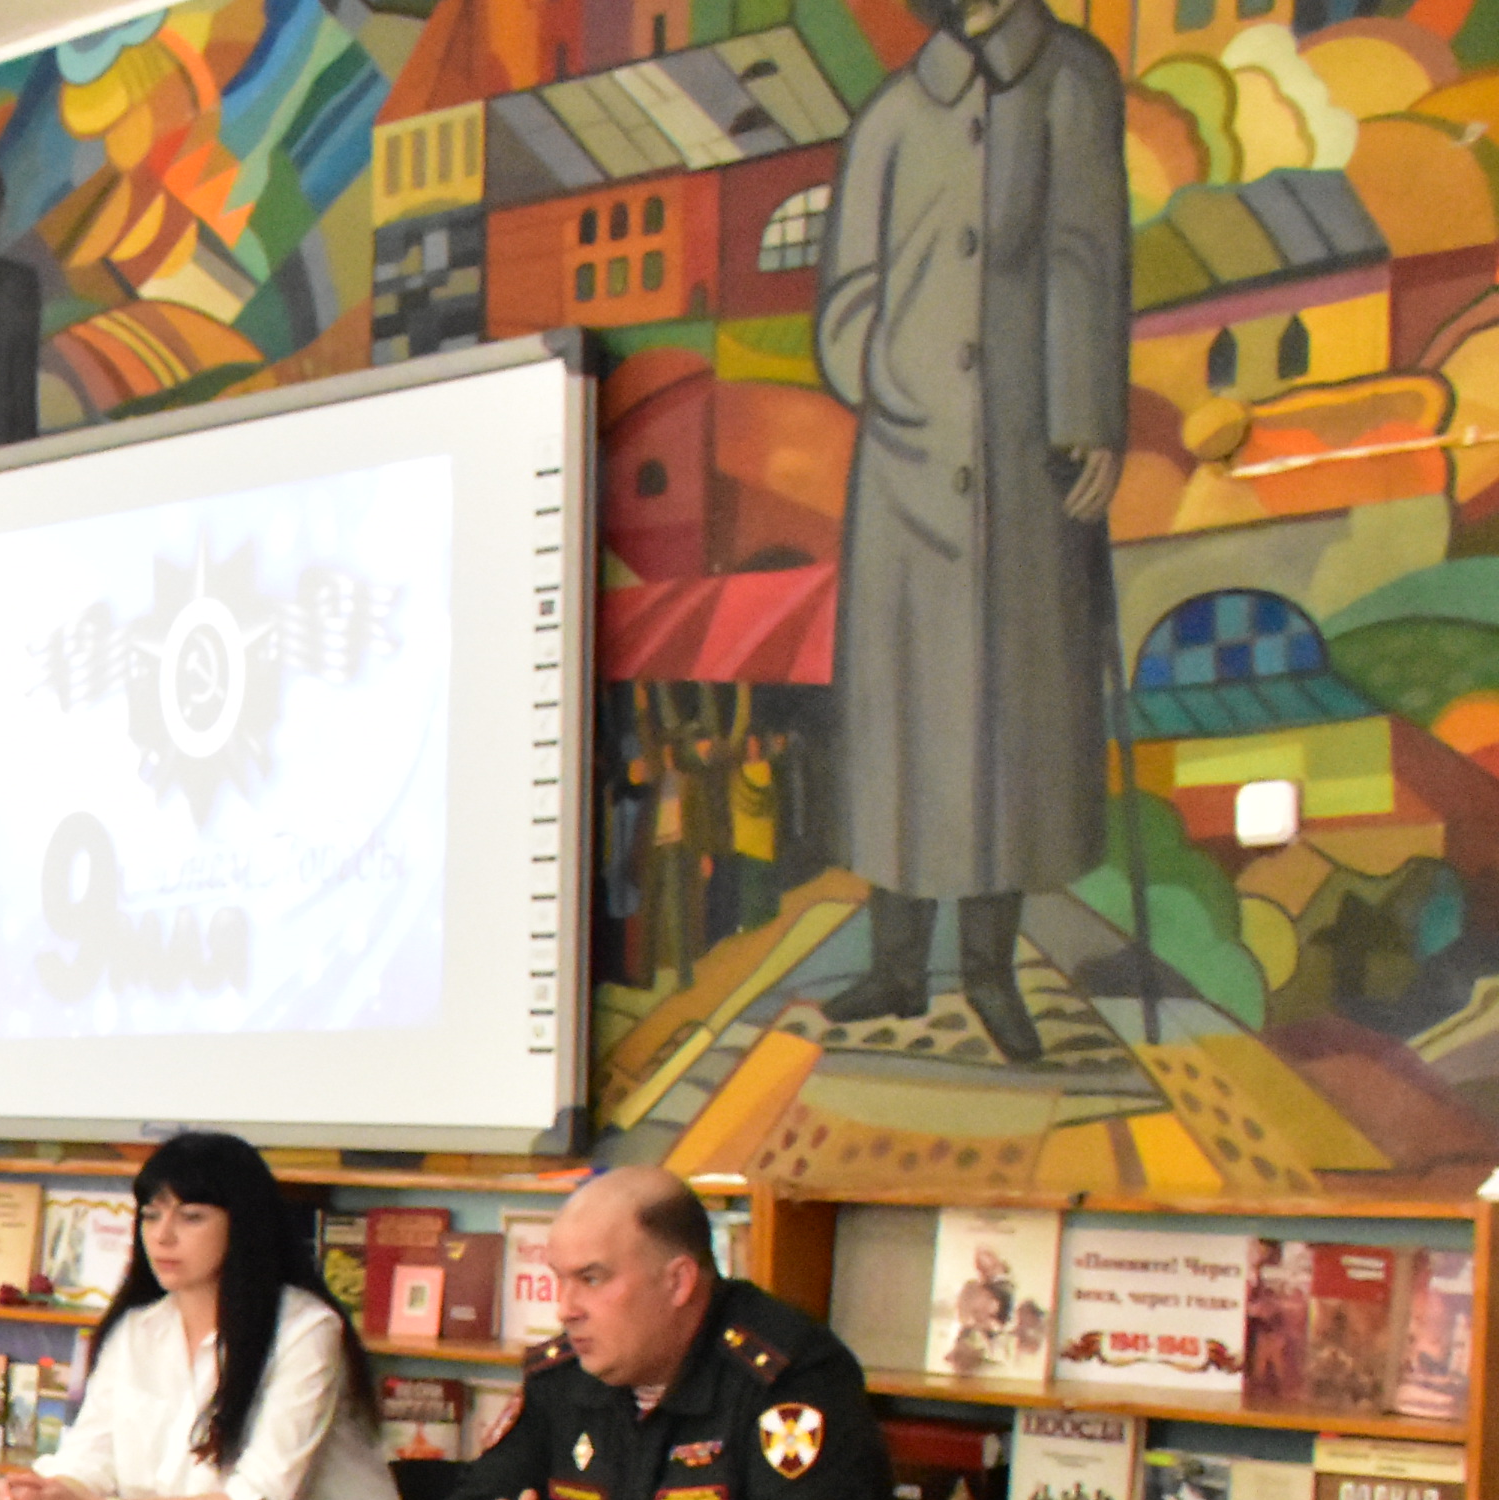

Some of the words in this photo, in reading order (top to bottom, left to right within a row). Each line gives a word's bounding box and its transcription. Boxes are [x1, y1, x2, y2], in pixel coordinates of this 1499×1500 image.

[32, 811, 120, 1004] 9
[1184, 1257, 1242, 1281] Через
[1128, 1292, 1180, 1310] через
